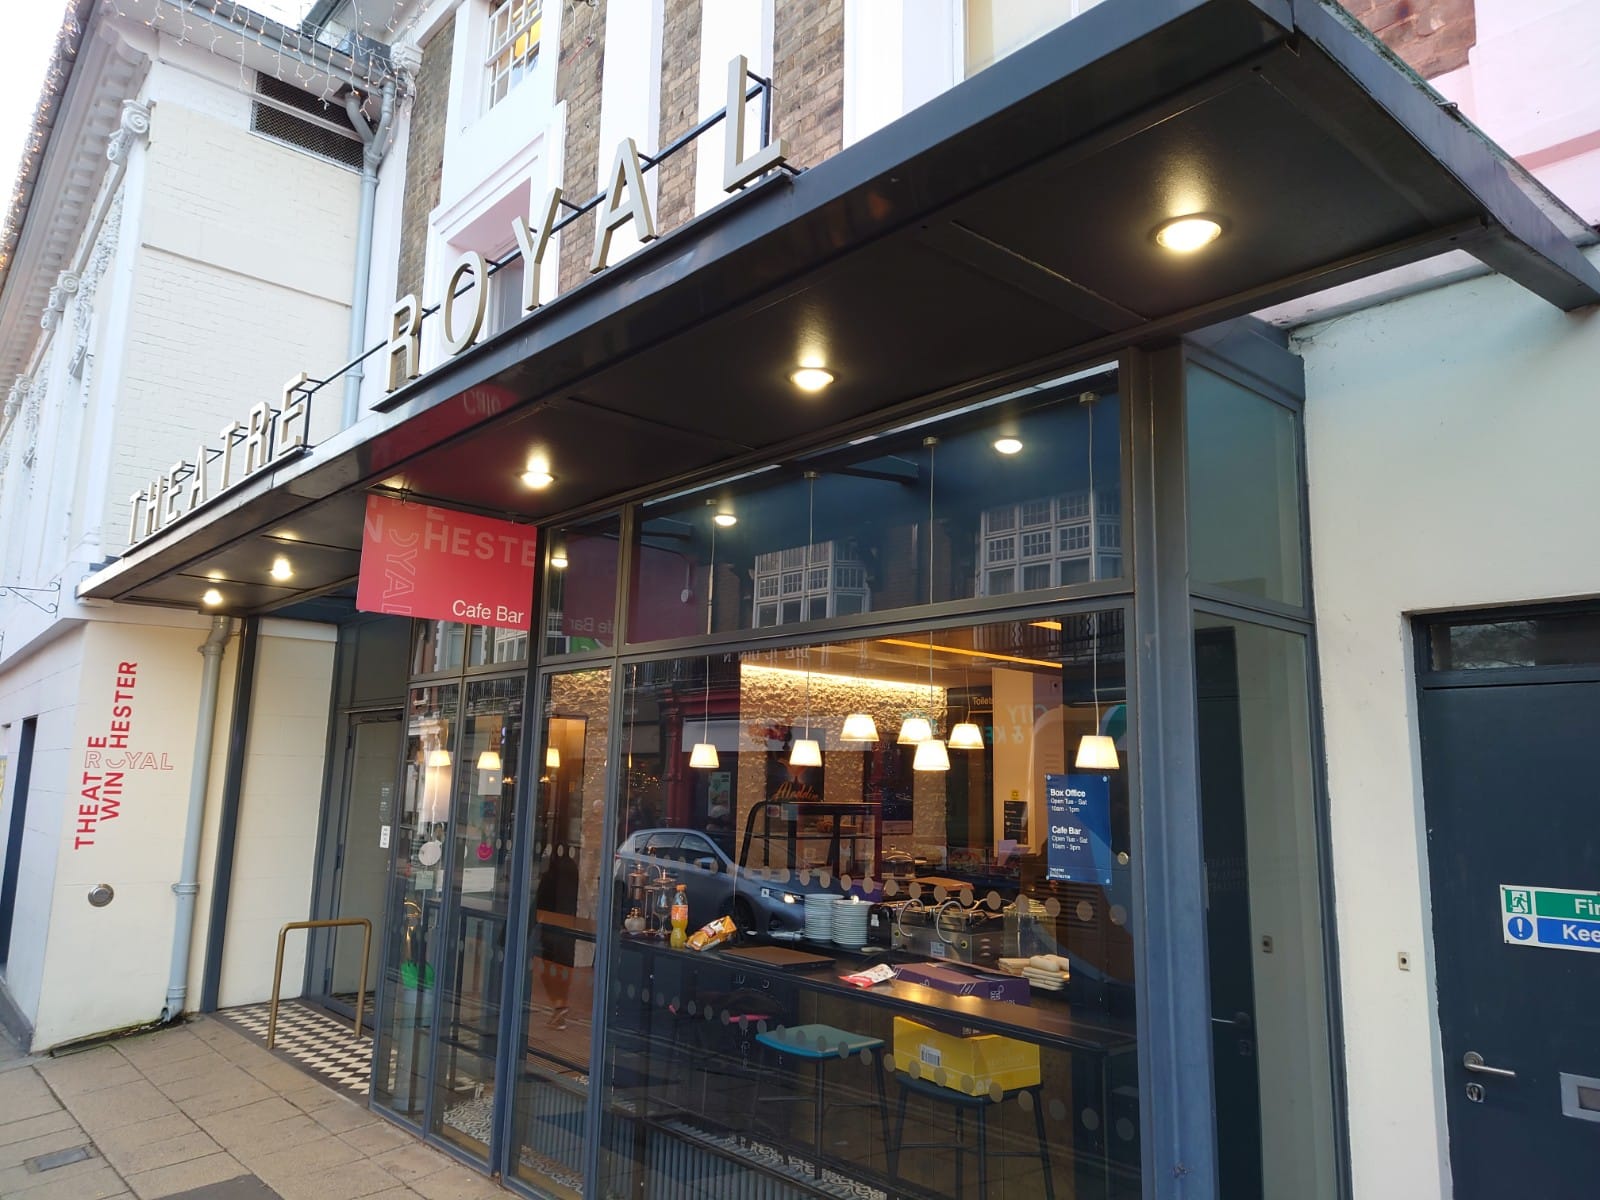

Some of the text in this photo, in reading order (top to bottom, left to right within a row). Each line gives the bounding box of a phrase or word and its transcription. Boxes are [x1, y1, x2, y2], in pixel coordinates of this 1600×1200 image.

[129, 54, 790, 545] THEATRE ROYAL
[452, 600, 525, 624] Cafe Bar
[1050, 788, 1086, 798] Box Office
[1051, 797, 1064, 805] Open
[1078, 798, 1088, 806] Sat
[1051, 825, 1082, 835] Cafe Bar
[1051, 835, 1066, 843] Open
[1080, 836, 1089, 844] Sat
